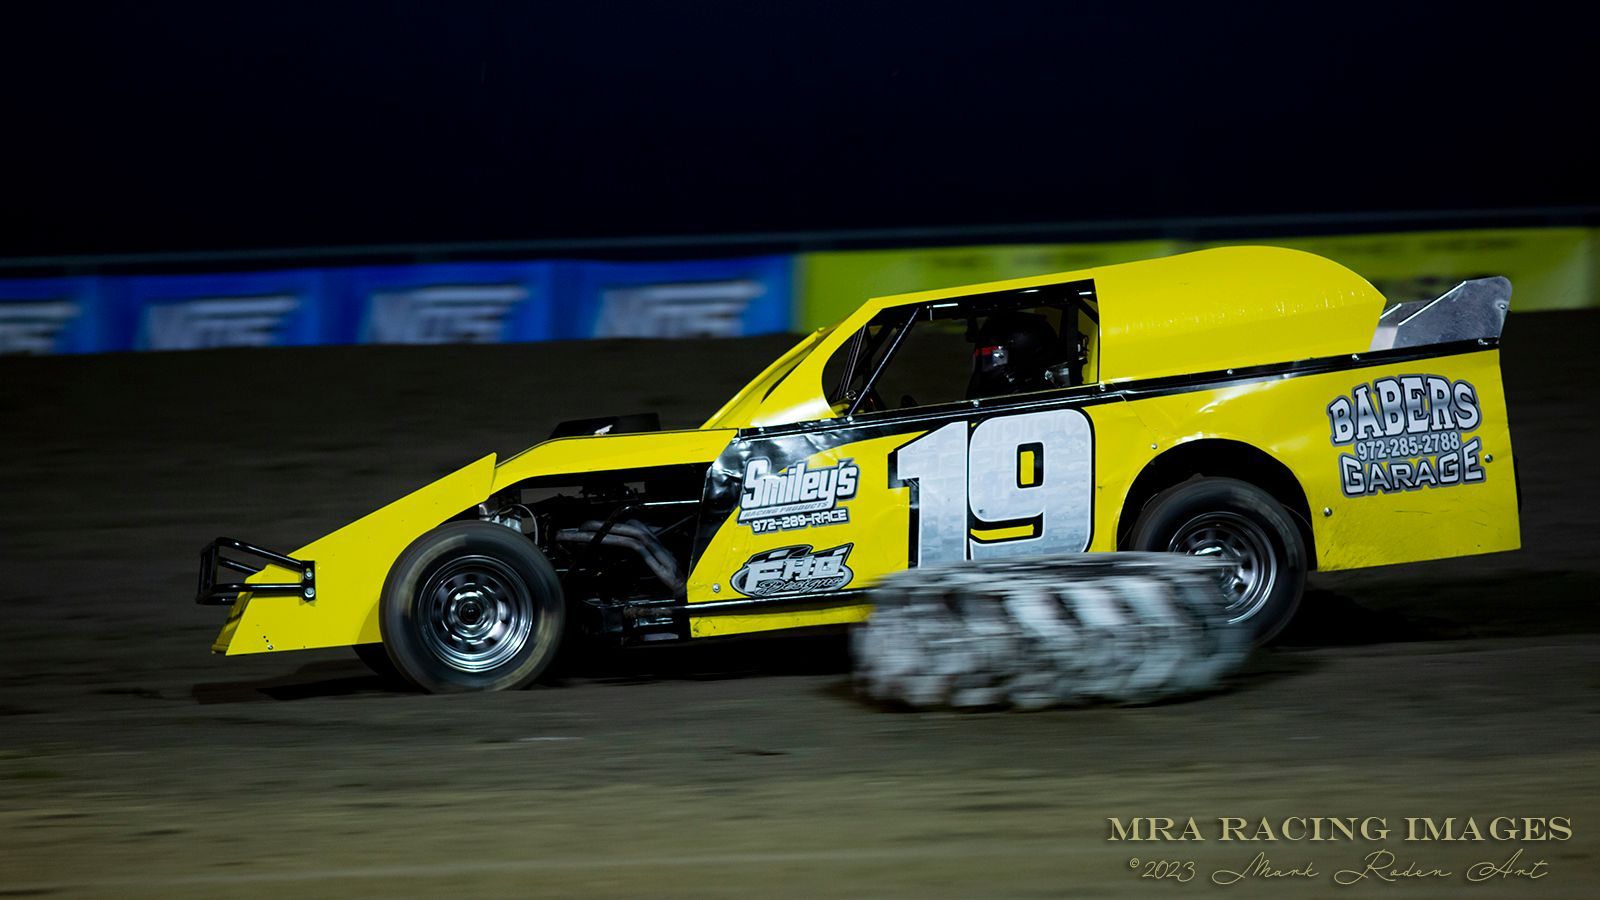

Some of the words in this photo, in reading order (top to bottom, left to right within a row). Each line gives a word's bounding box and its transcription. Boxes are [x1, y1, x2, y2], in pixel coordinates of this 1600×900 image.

[1329, 376, 1480, 443] BABERS
[1341, 440, 1483, 494] GARAGE
[1357, 431, 1460, 461] 972-285-2788
[741, 459, 858, 509] Smiley's
[893, 408, 1094, 570] 19
[743, 507, 779, 518] RACING
[779, 501, 830, 515] PRODUCTS
[752, 509, 848, 532] 972-289-RACE
